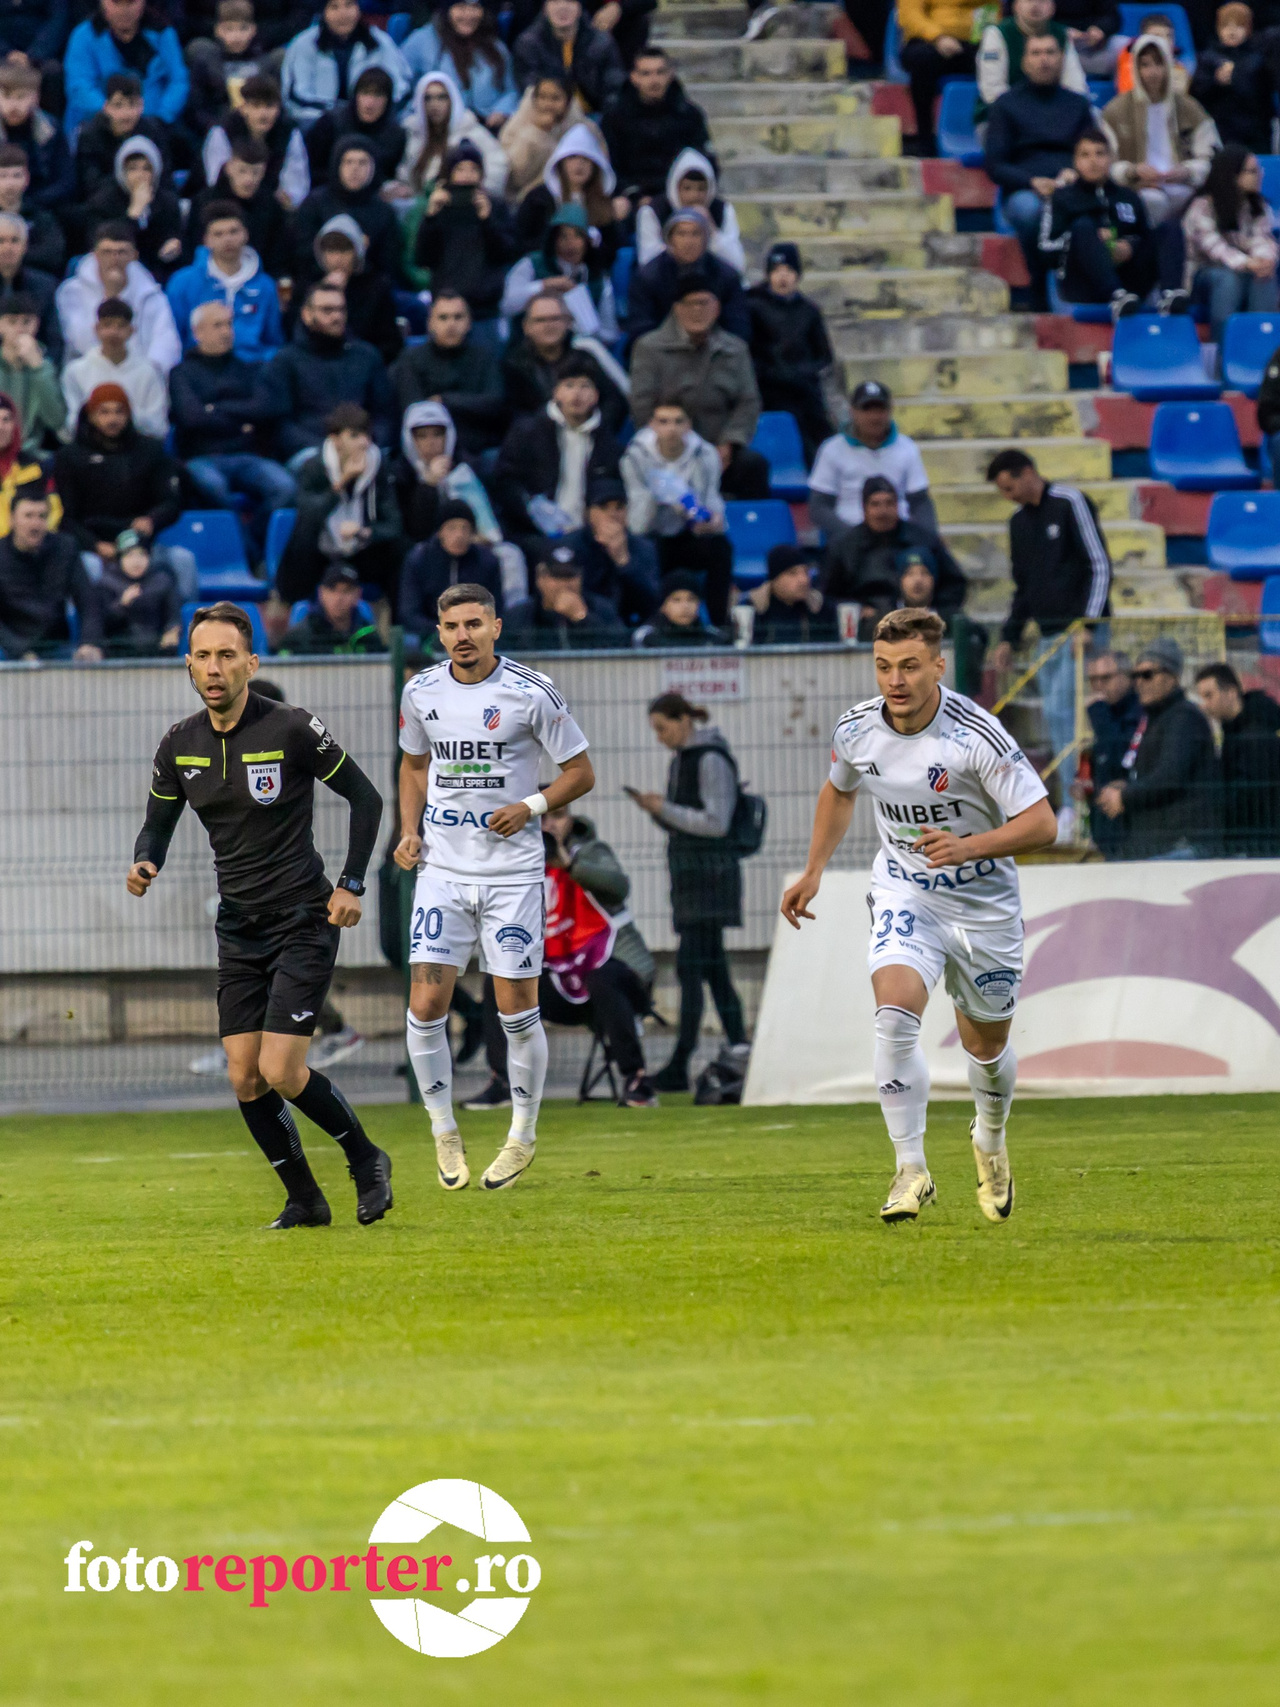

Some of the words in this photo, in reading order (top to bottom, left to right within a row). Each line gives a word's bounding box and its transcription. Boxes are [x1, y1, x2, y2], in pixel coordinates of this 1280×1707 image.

[465, 779, 486, 788] SPRE
[424, 804, 495, 829] ELSAC
[887, 858, 996, 891] ELSACO
[413, 907, 443, 940] 20
[877, 909, 915, 938] 33
[426, 945, 450, 954] Vestra
